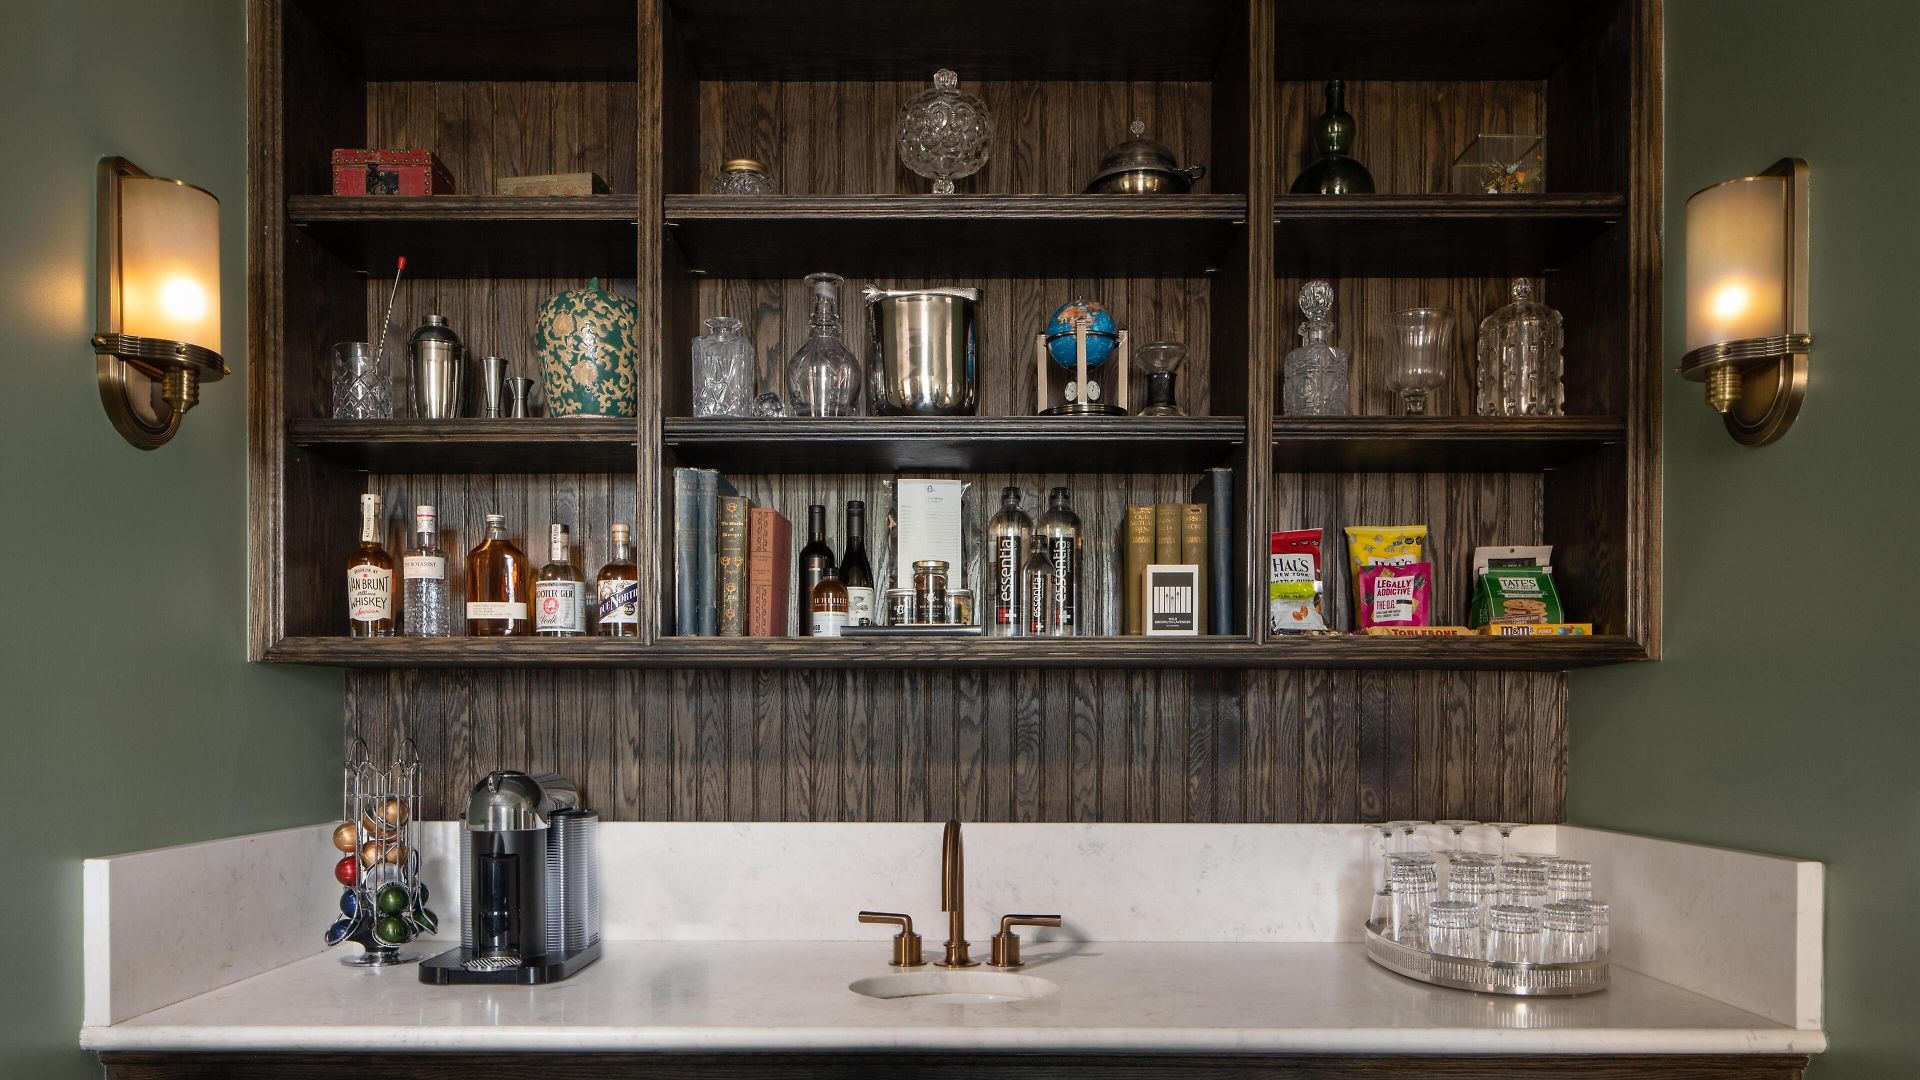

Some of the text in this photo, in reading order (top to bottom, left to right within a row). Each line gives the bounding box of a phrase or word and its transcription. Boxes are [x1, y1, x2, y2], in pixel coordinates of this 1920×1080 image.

[1000, 539, 1013, 602] essentia
[1272, 557, 1309, 573] HAL'S
[1053, 540, 1067, 603] essentia
[362, 576, 389, 593] BRUNT
[1377, 580, 1411, 589] LEGALLY
[1500, 579, 1537, 587] TATE'S
[1376, 588, 1411, 597] ADDICTIVE
[350, 597, 388, 610] WHISKEY
[1376, 600, 1386, 610] THE
[1391, 628, 1458, 636] TOBLERONE
